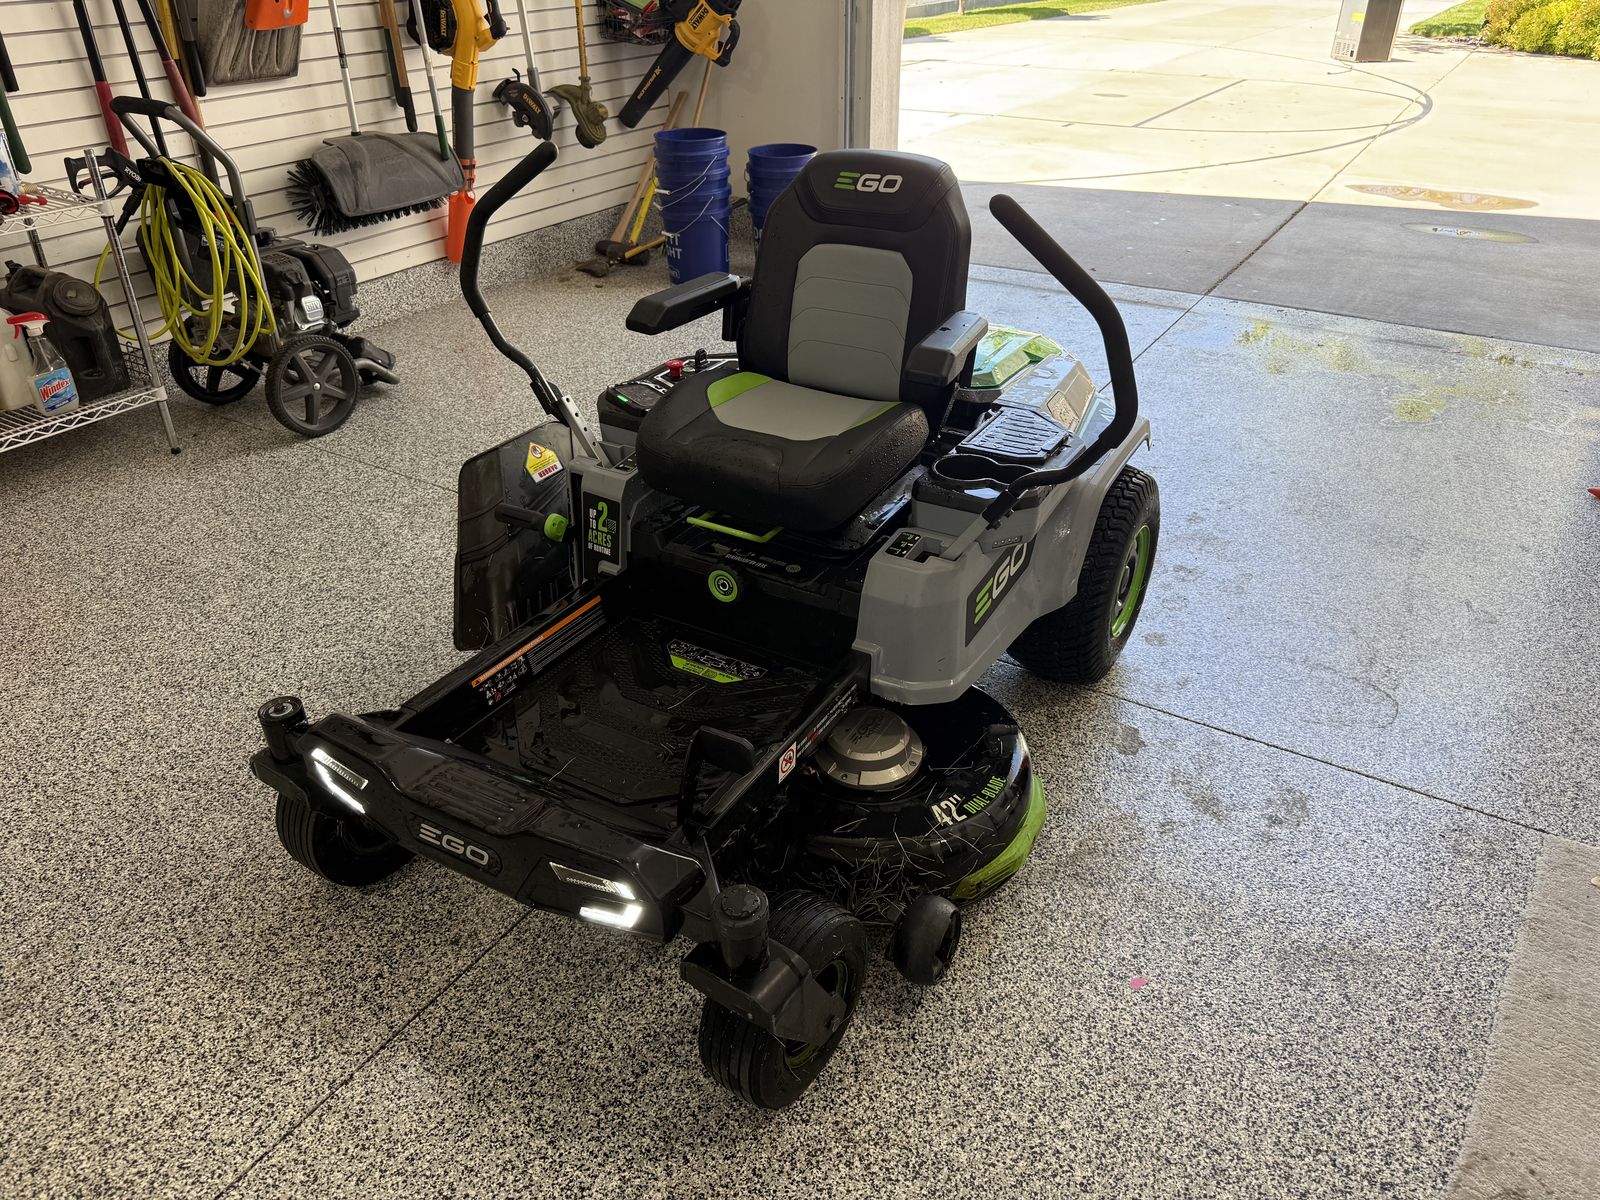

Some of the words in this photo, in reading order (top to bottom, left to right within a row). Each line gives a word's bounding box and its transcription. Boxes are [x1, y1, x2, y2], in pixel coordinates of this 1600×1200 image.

[124, 166, 142, 182] RYOBI
[833, 171, 903, 193] EGO
[39, 379, 70, 402] Windex
[597, 501, 608, 533] 2
[587, 528, 612, 548] ACRES
[973, 542, 1028, 625] EGO
[418, 823, 489, 866] EGO
